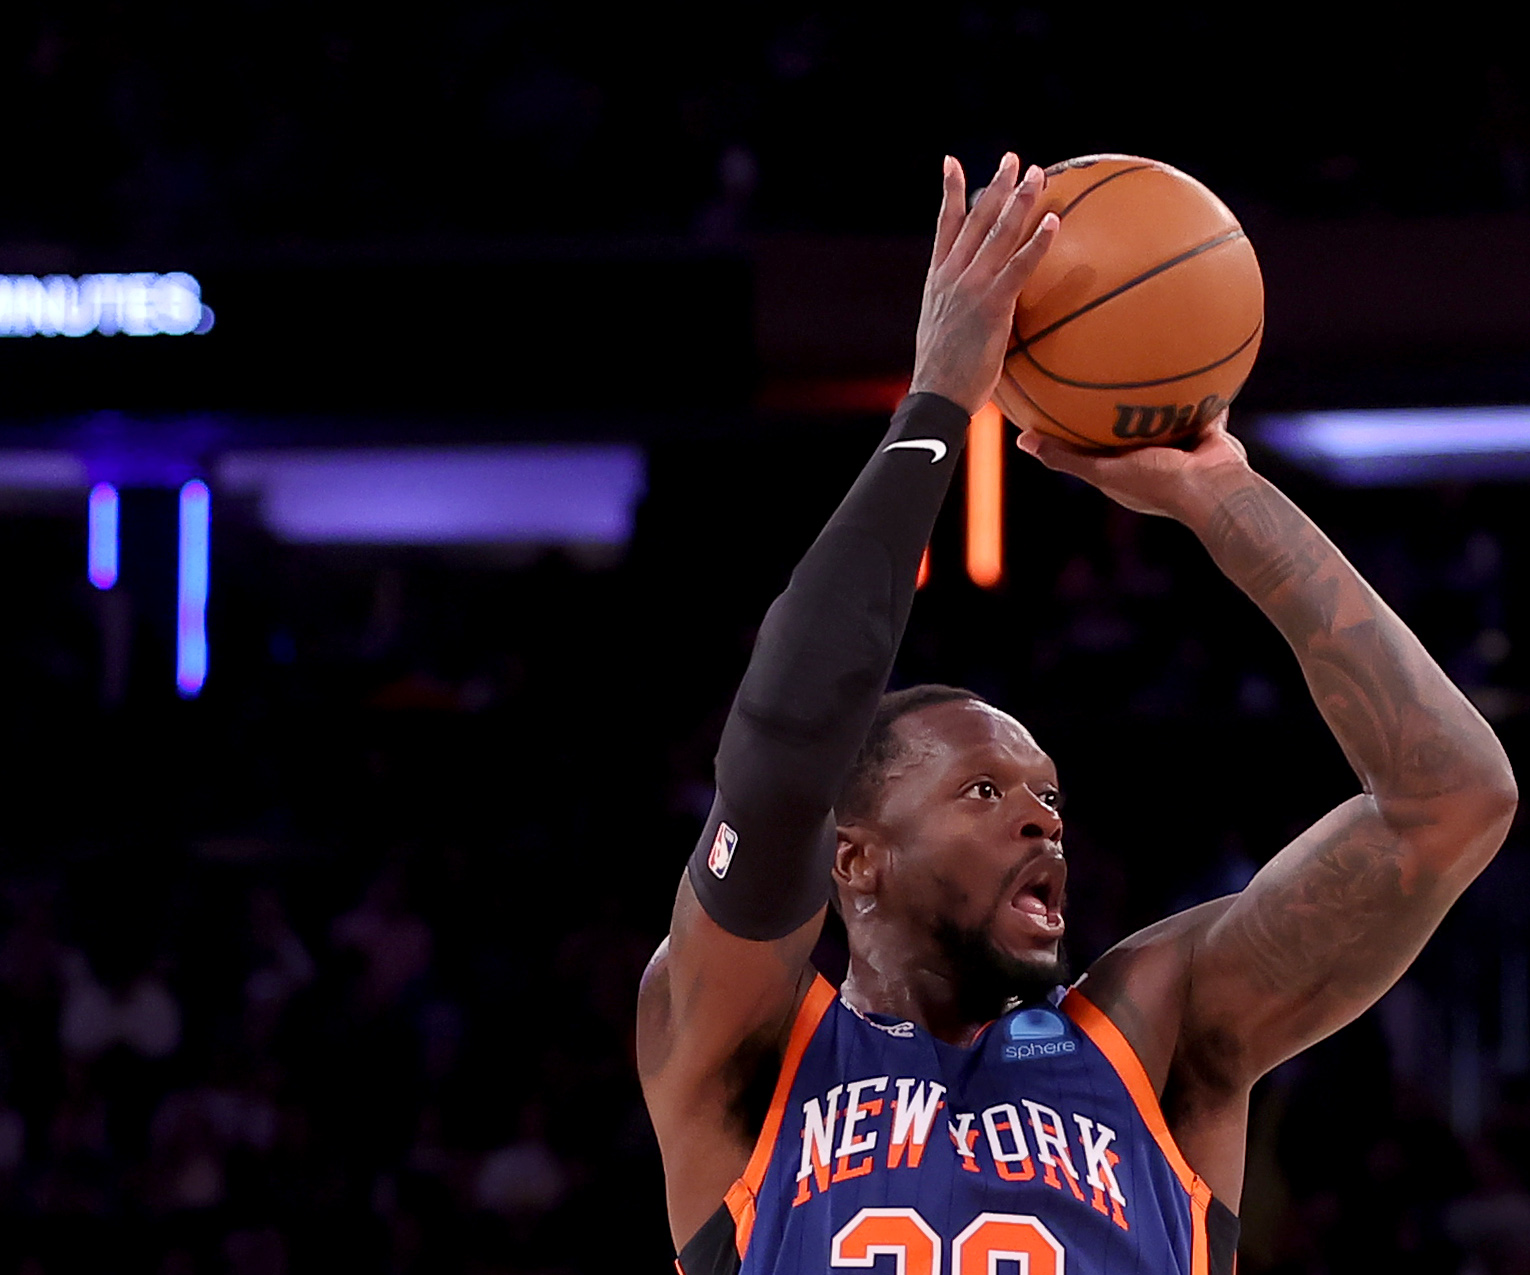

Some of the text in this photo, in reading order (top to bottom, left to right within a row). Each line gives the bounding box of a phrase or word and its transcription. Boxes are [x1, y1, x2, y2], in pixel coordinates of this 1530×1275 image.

[1005, 1041, 1076, 1060] sphere
[792, 1076, 1129, 1230] NEW YORK
